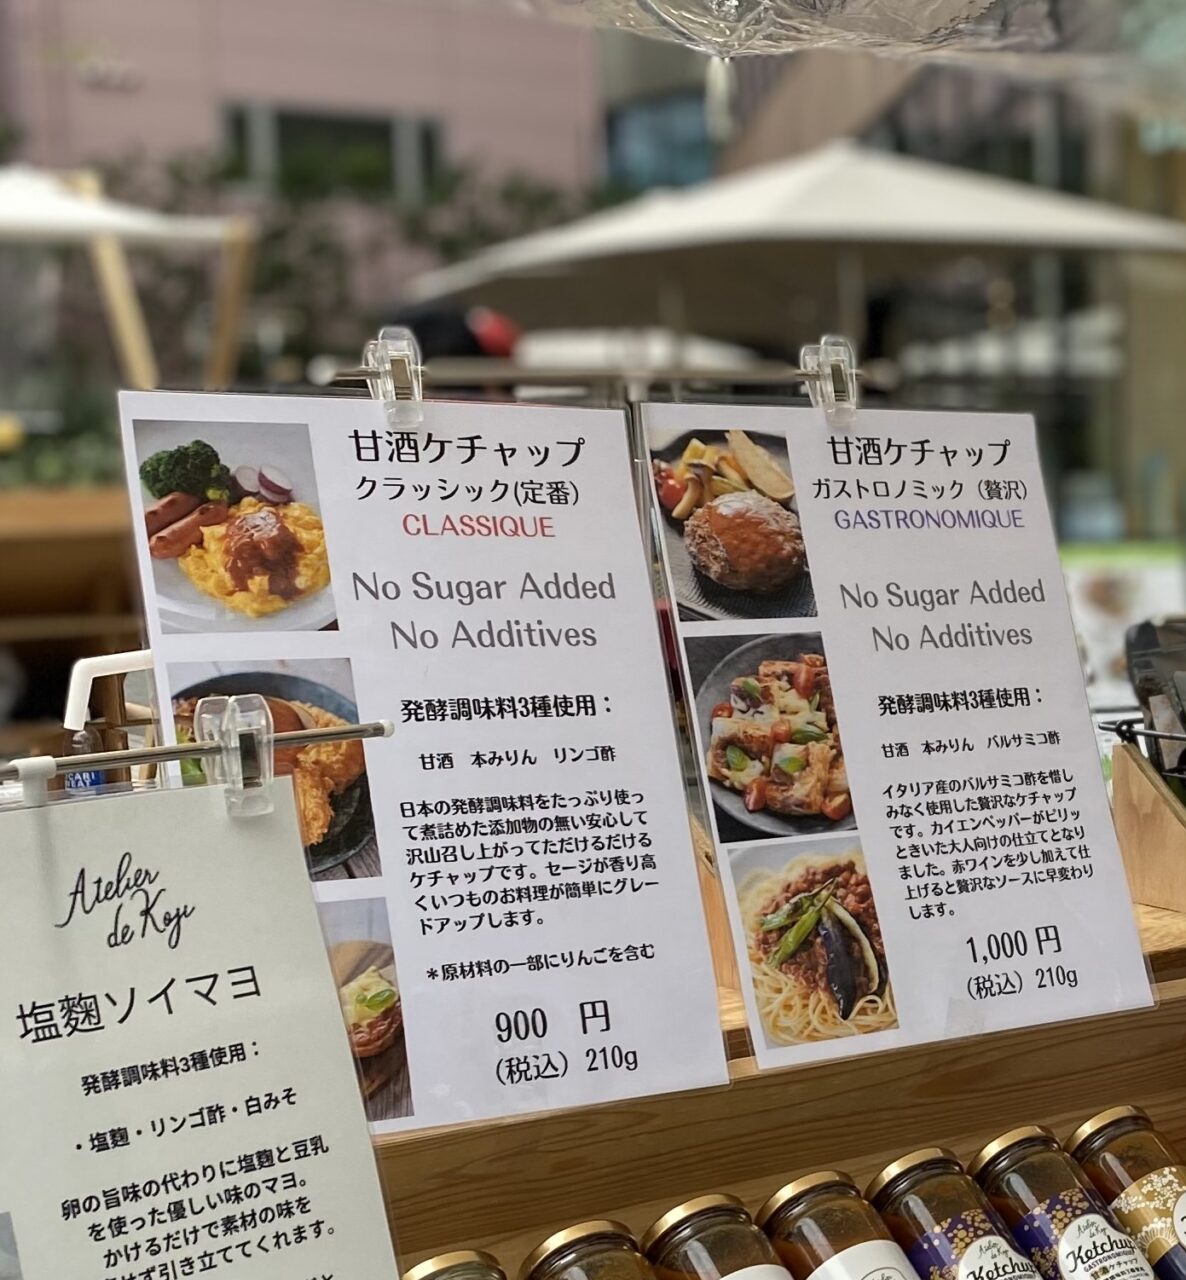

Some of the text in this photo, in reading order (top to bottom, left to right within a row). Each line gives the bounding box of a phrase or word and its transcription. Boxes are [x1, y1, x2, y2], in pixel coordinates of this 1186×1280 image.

[348, 430, 584, 468] 甘酒ケチャップ
[827, 436, 1011, 467] 甘酒ケチャップ
[402, 515, 555, 539] CLASSIQUE
[834, 509, 1024, 529] GASTRONOMIQUE
[352, 572, 615, 606] No Sugar Added
[839, 579, 1045, 612] No Sugar Added
[391, 621, 597, 650] No Additives
[872, 622, 1032, 652] No Additives
[419, 746, 616, 770] 甘酒 本みりん リンゴ酢
[881, 731, 1061, 759] 甘酒 本みりん バルサミコ酢
[882, 769, 1073, 799] イタリア産のバルサミコ酢を惜し
[400, 790, 644, 818] 日本の発酵調味料をたっぷり使っ
[886, 787, 1076, 819] みなく使用した贅沢なケチャップ
[402, 810, 648, 841] て煮詰めた添加物の無い安心して
[896, 826, 1085, 859] ときいた大人向けの仕立てとなり
[410, 853, 656, 888] ケチャップです。セージが香り高
[898, 845, 1091, 880] ました。赤ワインを少し加えて仕
[55, 852, 159, 928] Atelier
[414, 878, 659, 911] くいつものお料理が簡単にグレー
[904, 865, 1094, 900] 上げると贅沢なソースに早変わり
[107, 889, 195, 949] de Koji
[419, 910, 546, 935] ドアップします。
[910, 902, 956, 920] します。
[966, 925, 1062, 964] 1,000 円
[1035, 966, 1078, 989] 210g
[495, 1000, 611, 1043] 900 円
[585, 1045, 638, 1072] 210g
[88, 1171, 307, 1243] を使った優しい味のマヨ。
[103, 1196, 311, 1270] かけるだけで素材の味を
